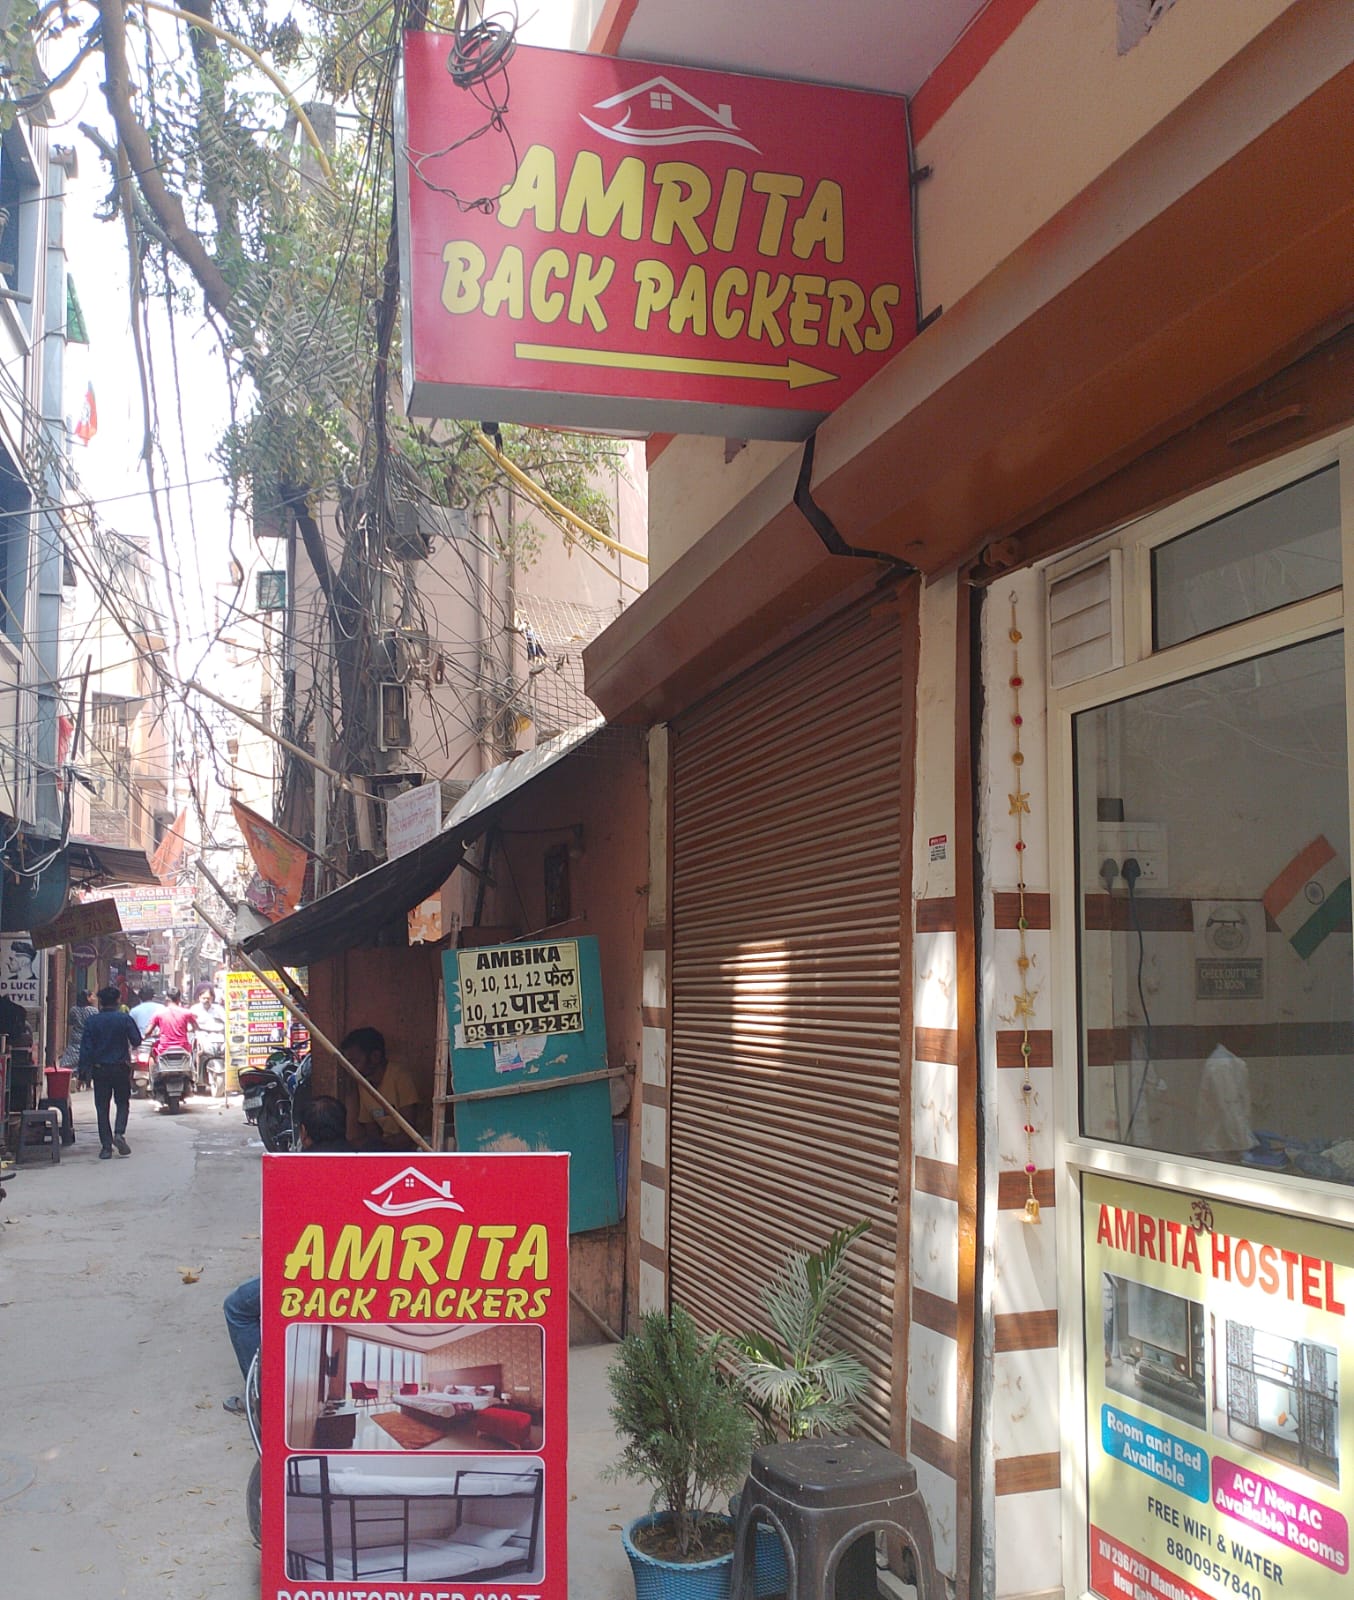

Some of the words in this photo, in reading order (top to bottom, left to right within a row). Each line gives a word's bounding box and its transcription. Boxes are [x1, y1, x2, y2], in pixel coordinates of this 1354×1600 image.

[498, 144, 846, 264] AMRITA
[441, 240, 615, 333] BACK
[633, 259, 900, 355] PACKERS
[476, 945, 561, 970] AMBIKA
[8, 993, 35, 1001] TYLE
[10, 982, 36, 990] LUCK
[465, 978, 477, 997] 9,
[481, 976, 500, 994] 10,
[504, 974, 523, 991] 11,
[526, 971, 541, 987] 12
[466, 1003, 487, 1022] 10,
[492, 1001, 508, 1018] 12
[509, 990, 560, 1014] पास
[467, 1025, 487, 1041] 98
[493, 1023, 510, 1037] 11
[515, 1019, 534, 1035] 92
[538, 1017, 557, 1031] 52
[561, 1014, 579, 1029] 54
[283, 1224, 549, 1285] AMRITA
[1097, 1203, 1202, 1274] AMRITA
[1211, 1232, 1345, 1316] HOSTEL
[280, 1288, 378, 1319] BACK
[388, 1287, 551, 1320] PACKERS
[1107, 1411, 1144, 1443] Room
[1146, 1434, 1171, 1457] and
[1174, 1443, 1201, 1472] Bed
[1123, 1442, 1185, 1487] Available
[1233, 1473, 1262, 1504] AC/
[1265, 1486, 1297, 1519] Non
[1298, 1504, 1322, 1530] AC
[1148, 1496, 1180, 1528] FREE
[1183, 1514, 1212, 1546] WIFI
[1217, 1534, 1226, 1554] &
[1231, 1541, 1284, 1586] WATER
[1216, 1488, 1285, 1537] Available
[1287, 1522, 1345, 1567] Rooms
[1111, 1547, 1150, 1584] 296/297
[1113, 1569, 1133, 1596] New
[1166, 1537, 1262, 1600] 8800957840
